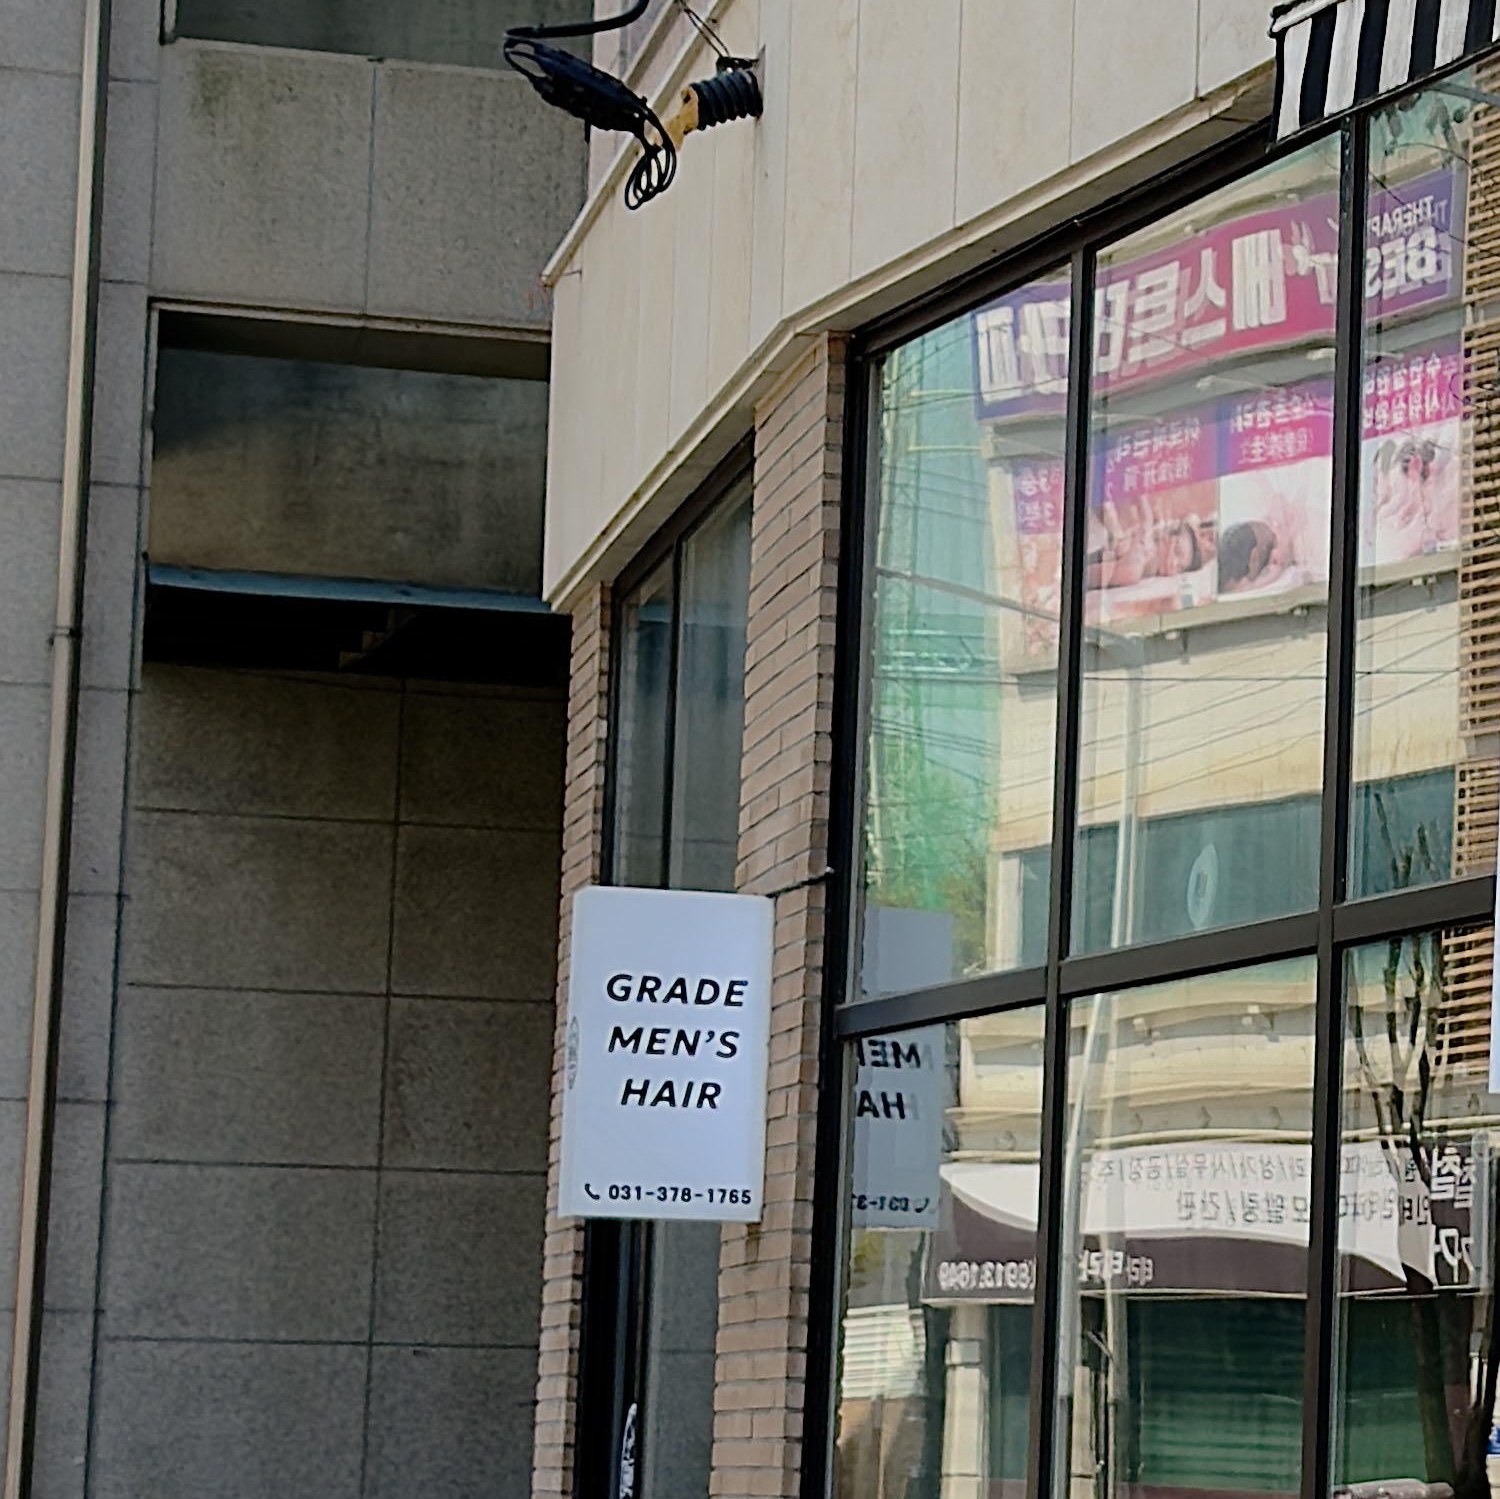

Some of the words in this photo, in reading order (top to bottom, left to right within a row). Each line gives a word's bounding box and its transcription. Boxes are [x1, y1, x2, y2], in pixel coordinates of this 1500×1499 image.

[606, 974, 749, 1007] GRADE
[608, 1026, 740, 1059] MEN'S
[620, 1078, 722, 1110] HAIR
[608, 1184, 752, 1205] 031-378-1765
